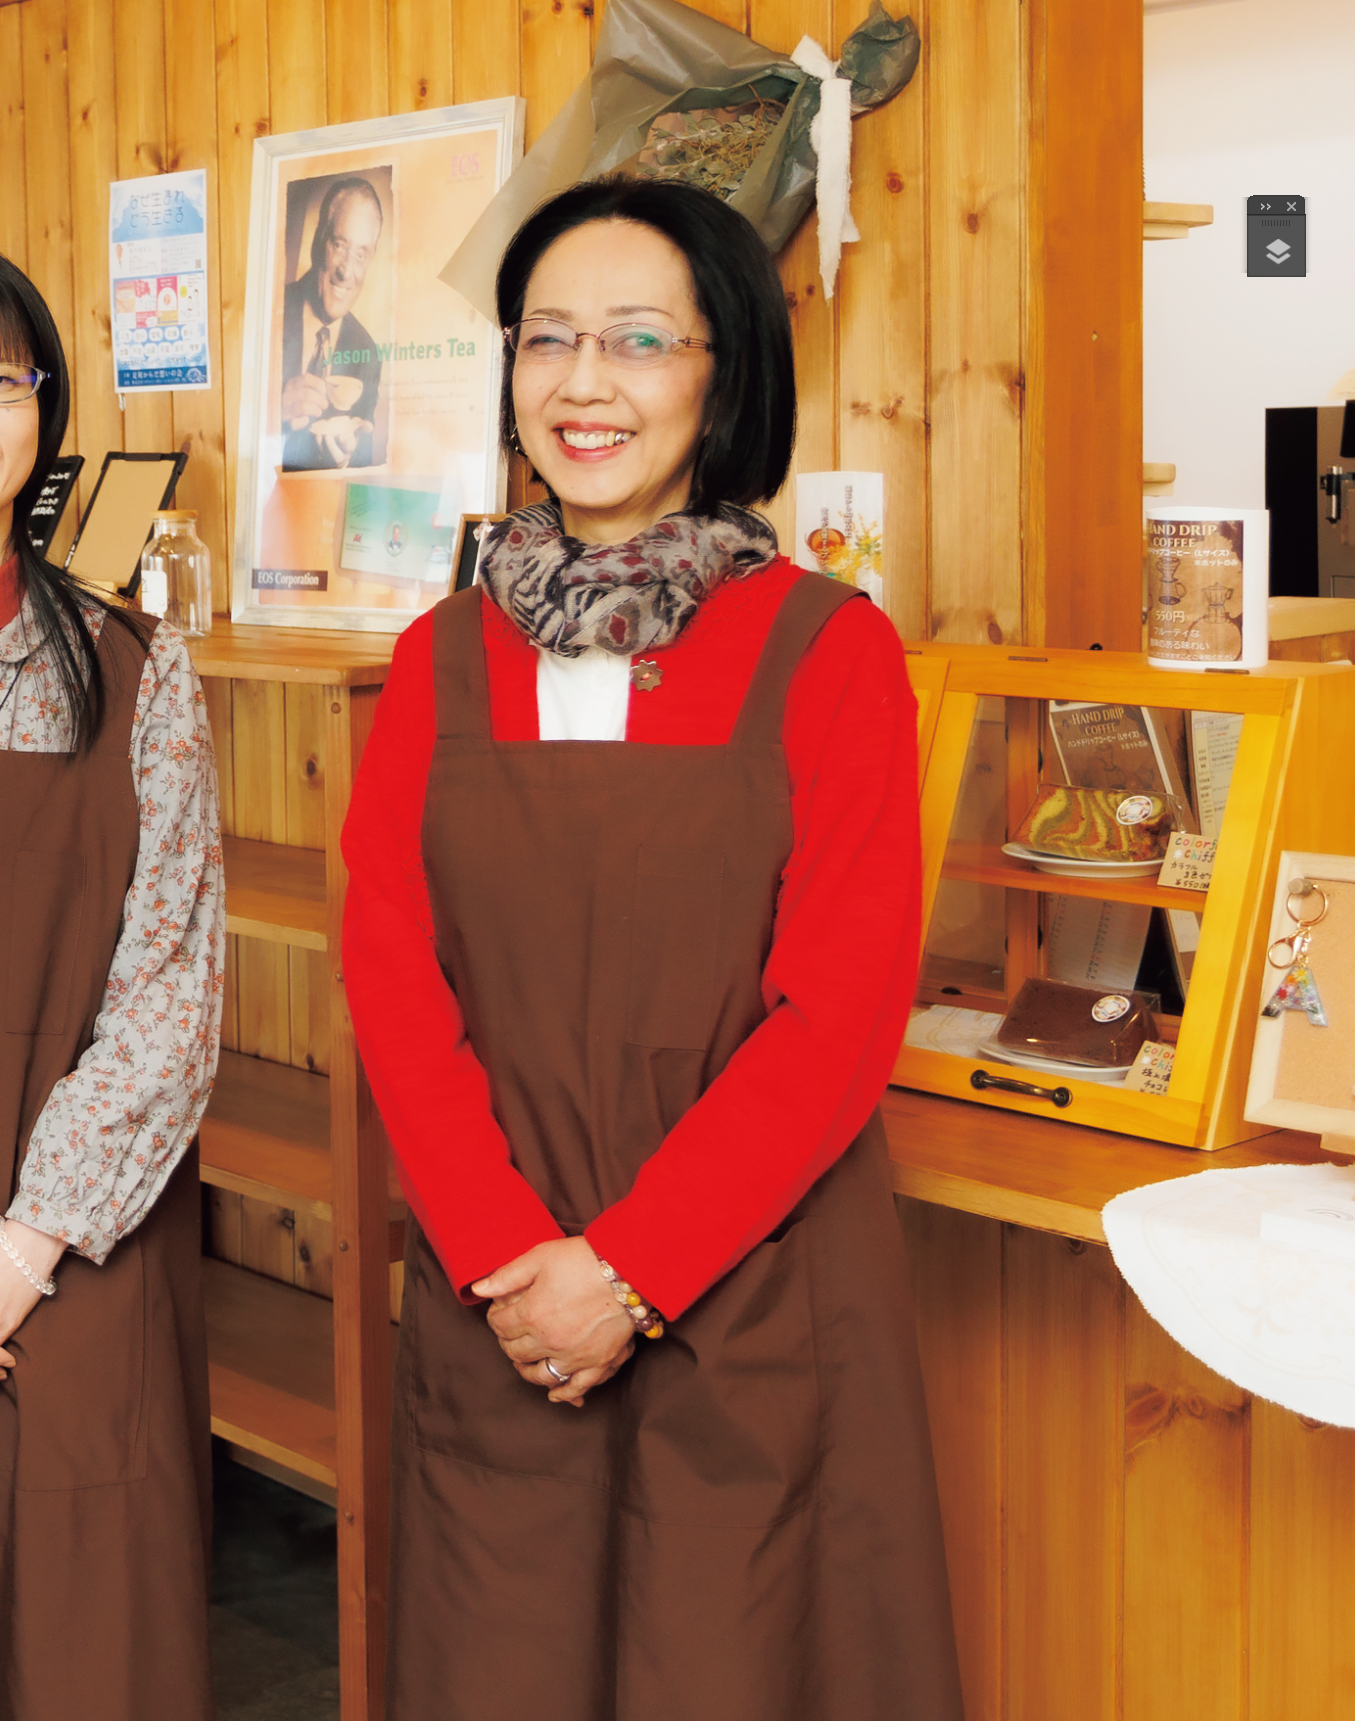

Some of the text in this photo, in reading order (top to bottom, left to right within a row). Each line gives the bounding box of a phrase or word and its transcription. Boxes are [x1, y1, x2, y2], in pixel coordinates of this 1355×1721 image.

[451, 152, 480, 178] EOS
[323, 338, 476, 366] Jason Winters Tea
[1179, 524, 1219, 536] DRIP
[1153, 536, 1197, 548] COFFEE
[257, 571, 320, 588] EOS Corporation
[1155, 610, 1185, 623] 550円
[1153, 626, 1201, 638] フルーティな
[1071, 707, 1125, 725] HAND DRIP
[1085, 722, 1117, 736] COFFEE
